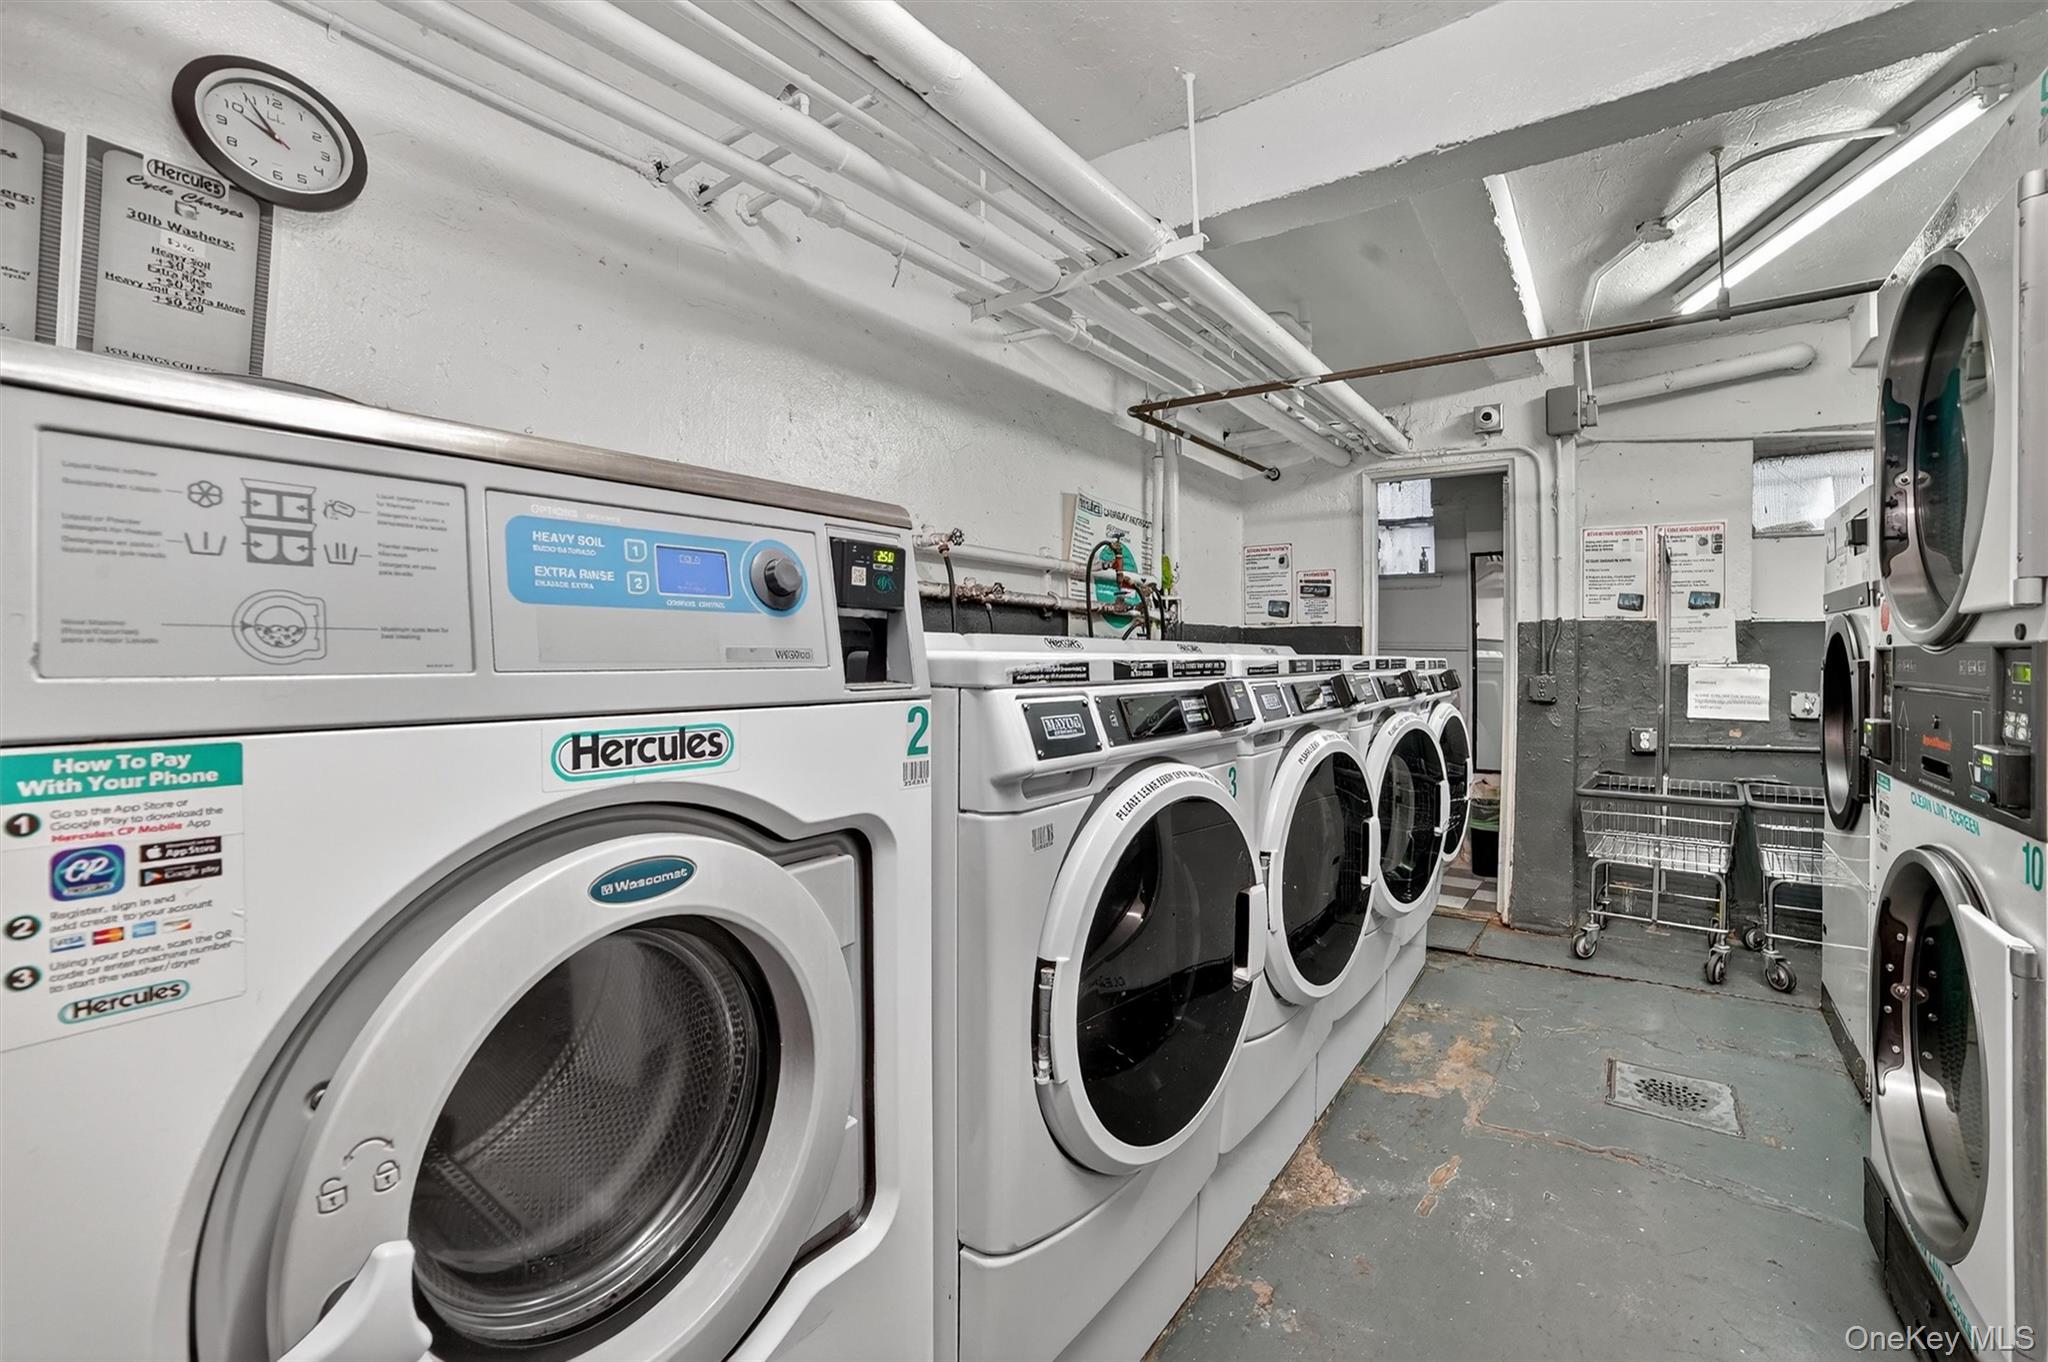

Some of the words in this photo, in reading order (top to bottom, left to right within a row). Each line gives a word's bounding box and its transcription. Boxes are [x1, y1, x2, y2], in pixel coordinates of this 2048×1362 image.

[224, 99, 244, 114] 10
[266, 95, 283, 110] 12
[216, 114, 228, 126] 9
[226, 135, 238, 147] 8
[312, 131, 322, 143] 2
[248, 156, 259, 167] 7
[320, 151, 331, 162] 3
[154, 160, 221, 195] Hercules
[272, 170, 283, 181] 6
[297, 173, 307, 184] 5
[313, 165, 324, 176] 4
[127, 175, 174, 196] Cycle
[181, 193, 244, 218] Charges
[127, 208, 162, 226] 30lb
[167, 220, 236, 250] Washers:
[151, 246, 187, 263] Heavy
[105, 272, 143, 289] Heavy
[533, 530, 575, 544] HEAVY
[577, 535, 606, 548] SOIL
[535, 566, 577, 579] EXTRA
[579, 569, 615, 582] RINSE
[907, 706, 929, 756] 2
[571, 726, 723, 770] Hercules
[53, 758, 112, 776] How
[116, 754, 146, 770] To
[151, 752, 191, 769] Pay
[16, 777, 83, 797] With
[86, 775, 146, 792] Your
[149, 768, 219, 786] Phone
[1229, 767, 1237, 799] 3
[50, 809, 71, 821] Go
[74, 807, 87, 817] to
[90, 805, 111, 816] the
[114, 803, 141, 815] App
[144, 800, 173, 811] Store
[176, 800, 188, 809] or
[50, 818, 100, 832] Google
[104, 815, 127, 827] Play
[131, 814, 143, 823] to
[146, 807, 202, 822] download
[206, 805, 224, 816] the
[1910, 791, 1933, 813] CLEAN
[1933, 800, 1949, 820] LINT
[1949, 808, 1980, 836] SCREEN
[52, 829, 114, 842] Hercules
[117, 826, 135, 836] CP
[138, 822, 182, 835] Mobile
[187, 818, 211, 830] App
[165, 847, 189, 858] App
[189, 844, 217, 855] Store
[64, 856, 109, 883] CP
[2022, 842, 2043, 892] 10
[614, 868, 688, 893] Wascomat
[50, 905, 105, 921] Register,
[111, 901, 137, 914] sign
[140, 898, 152, 907] in
[155, 894, 176, 905] and
[50, 921, 77, 933] add
[80, 916, 117, 929] credit
[123, 913, 136, 923] to
[137, 908, 167, 921] your
[169, 899, 213, 914] account
[50, 959, 88, 975] Using
[90, 952, 119, 966] your
[122, 943, 164, 959] phone,
[167, 938, 193, 949] scan
[195, 932, 213, 944] the
[214, 929, 232, 940] QR
[50, 970, 83, 983] code
[87, 966, 101, 976] or
[104, 960, 135, 973] enter
[138, 949, 187, 966] machine
[190, 940, 233, 957] number
[49, 984, 64, 994] to
[67, 978, 96, 991] start
[98, 972, 120, 985] the
[121, 957, 201, 981] washer/dryer
[72, 983, 181, 1019] Hercules
